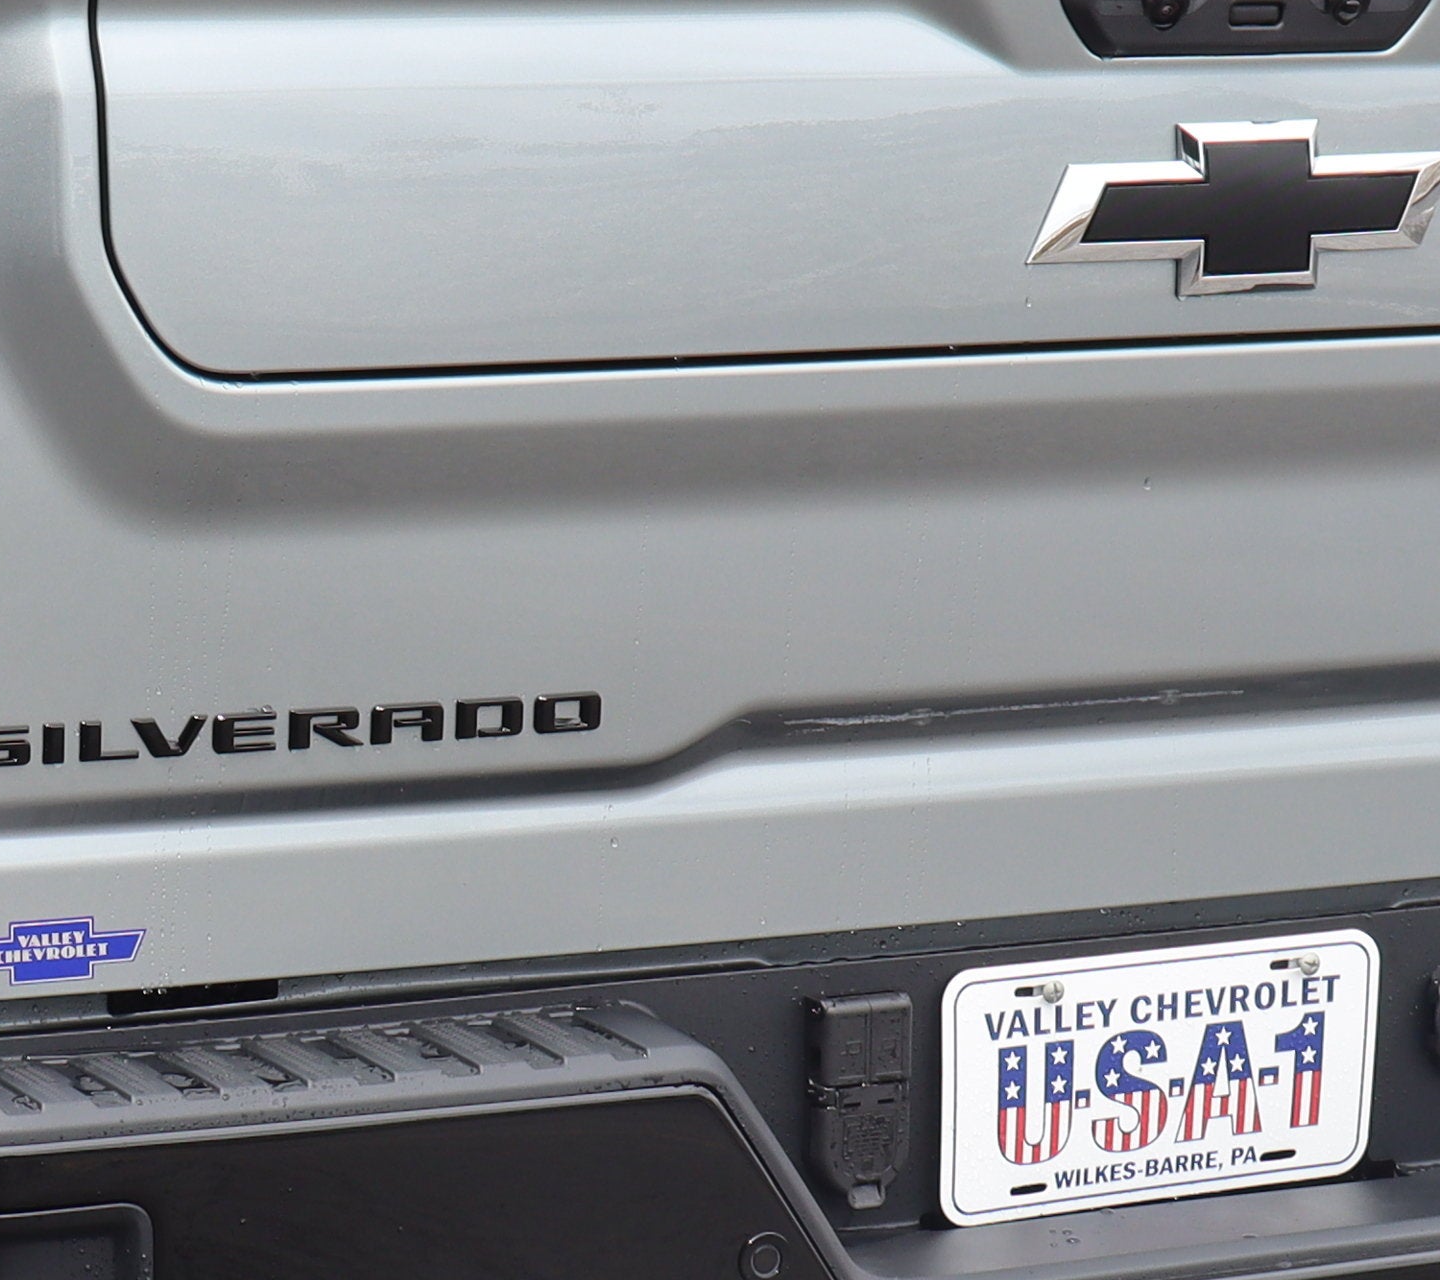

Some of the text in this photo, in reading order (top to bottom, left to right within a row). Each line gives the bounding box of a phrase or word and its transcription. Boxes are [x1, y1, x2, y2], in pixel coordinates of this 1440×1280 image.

[18, 930, 86, 948] VALLEY
[984, 974, 1342, 1042] VALLEY CHEVROLET
[1054, 1146, 1259, 1191] WILKES-BARRE, PA
